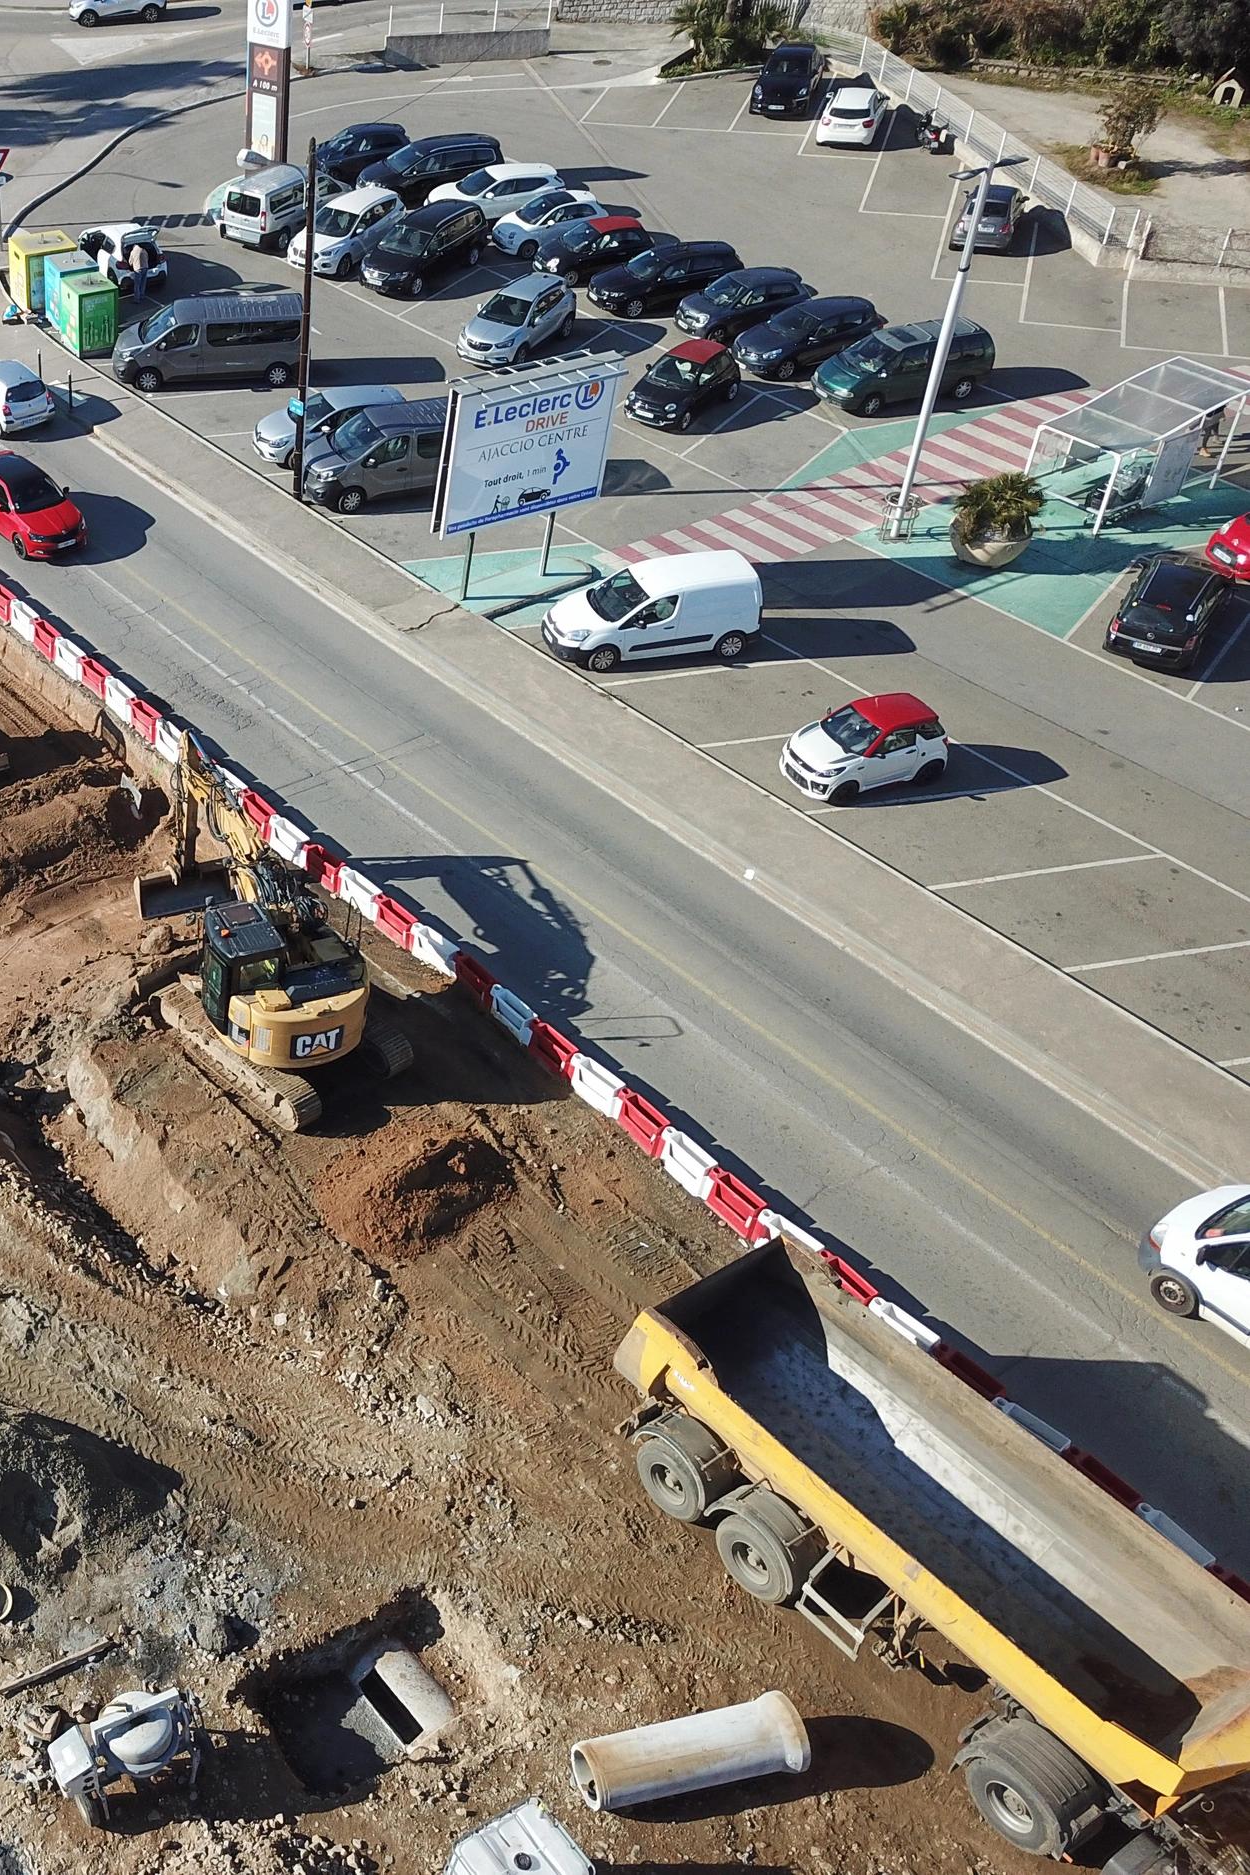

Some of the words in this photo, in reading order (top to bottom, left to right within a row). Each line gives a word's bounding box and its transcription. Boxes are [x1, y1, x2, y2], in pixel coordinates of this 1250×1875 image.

[252, 80, 258, 88] A
[259, 81, 270, 91] 100
[474, 391, 572, 430] E.Leclerc
[525, 411, 569, 434] DRIVE
[478, 438, 536, 463] AJACCIO
[537, 425, 589, 447] CENTRE
[484, 475, 502, 488] Tout
[502, 470, 524, 484] droit,
[526, 468, 531, 478] 1
[531, 465, 547, 477] min
[295, 1028, 341, 1058] CAT
